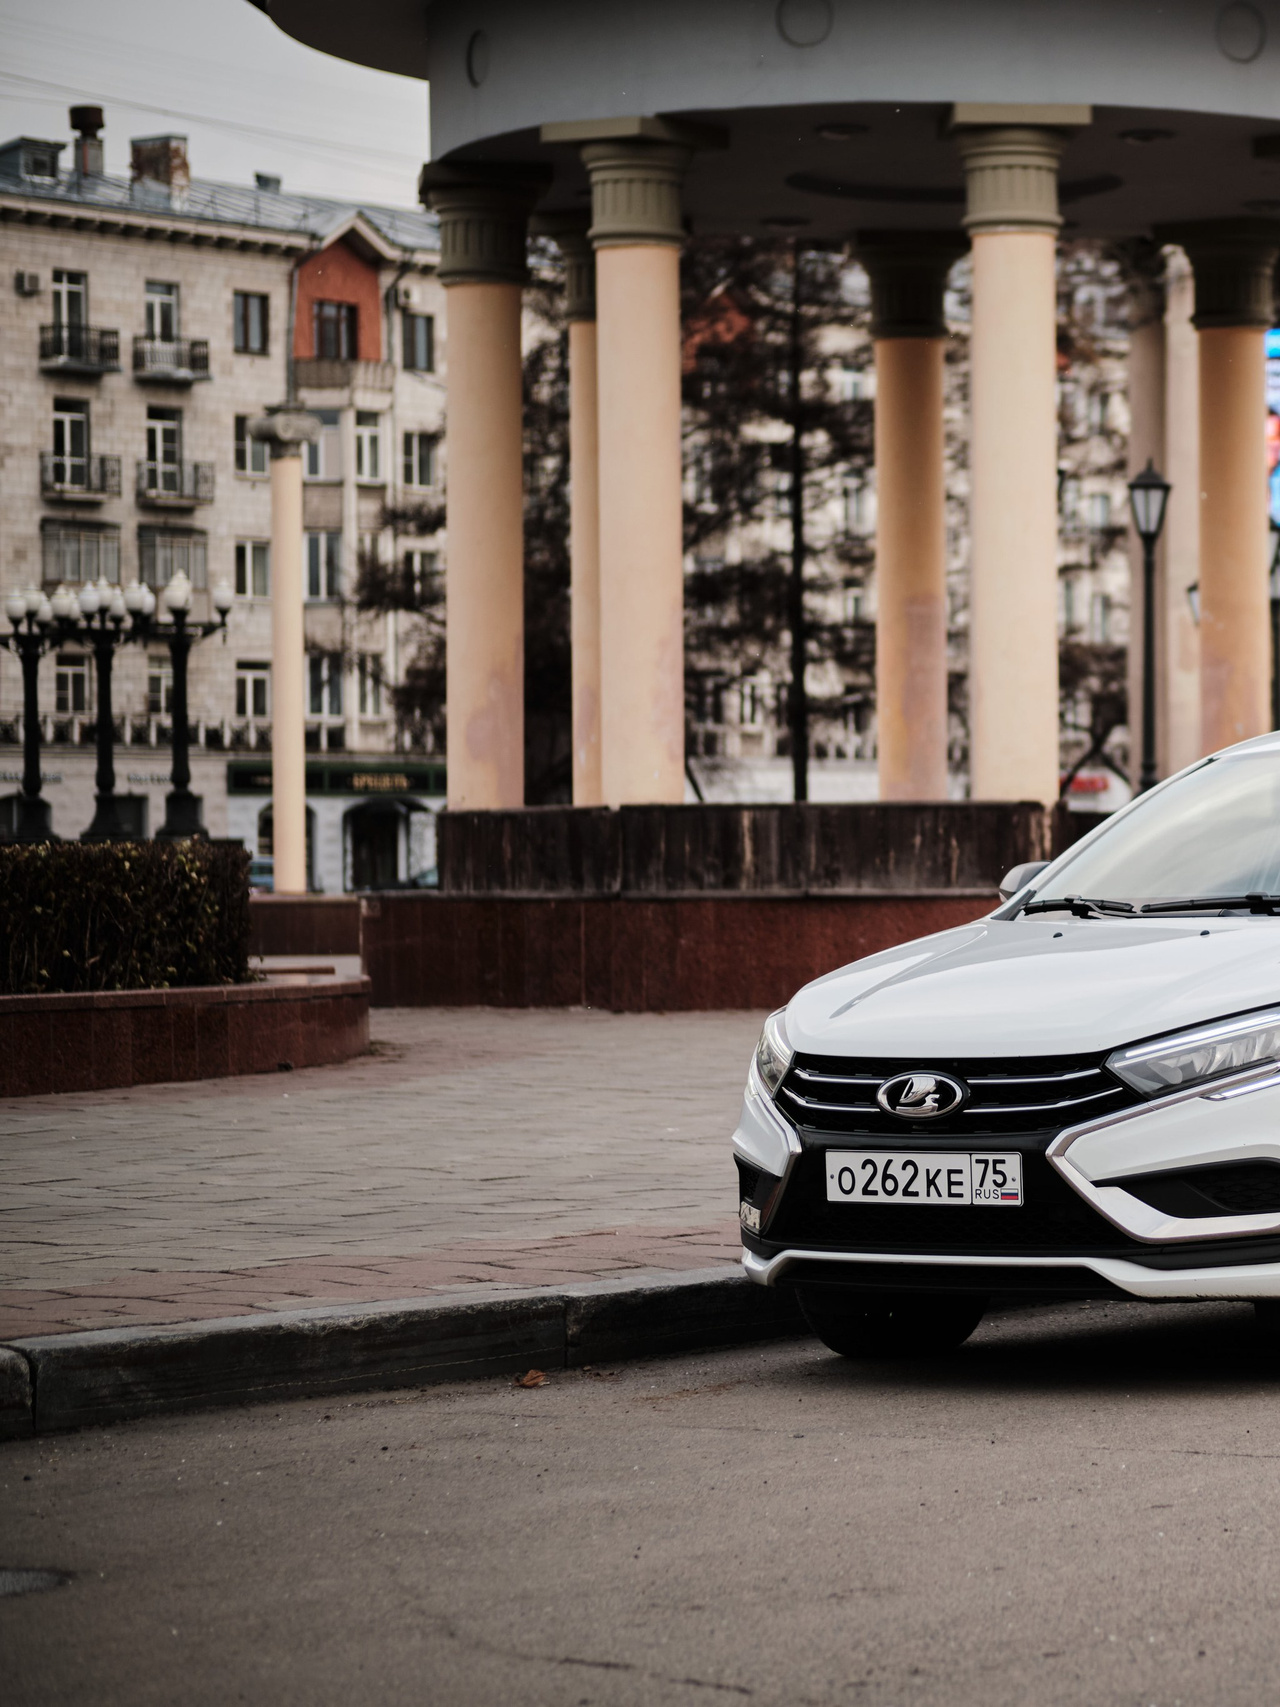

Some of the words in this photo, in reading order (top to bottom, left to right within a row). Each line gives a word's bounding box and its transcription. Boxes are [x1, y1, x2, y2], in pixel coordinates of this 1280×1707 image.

[837, 1158, 965, 1199] О262КЕ
[974, 1158, 1008, 1189] 75
[974, 1188, 1000, 1200] RUS
